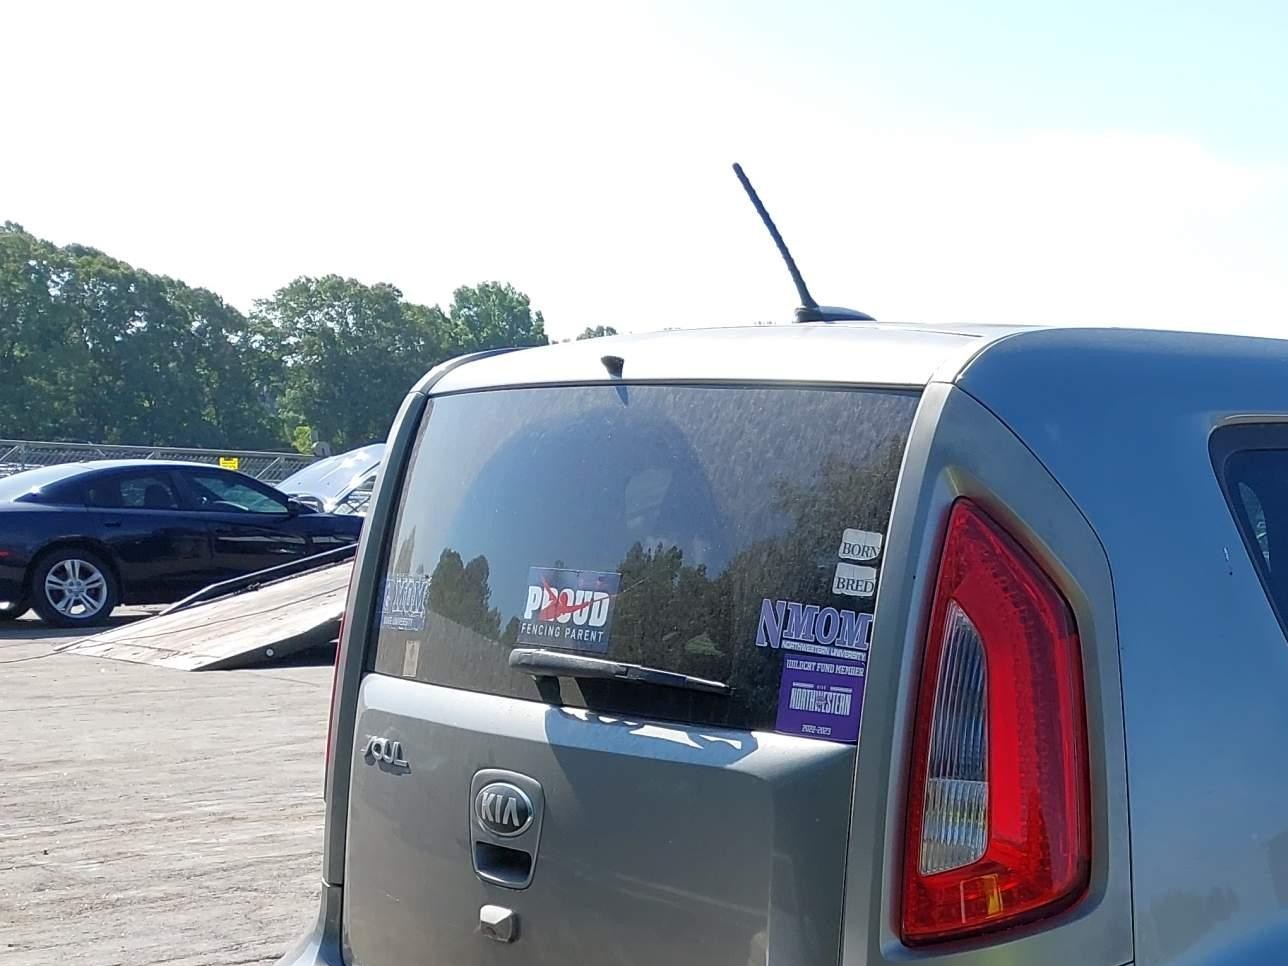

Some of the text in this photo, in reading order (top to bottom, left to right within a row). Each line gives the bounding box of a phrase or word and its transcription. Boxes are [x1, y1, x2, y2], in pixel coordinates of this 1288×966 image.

[841, 542, 881, 558] BORN
[836, 577, 875, 593] BRED
[520, 622, 604, 642] FENCING PARENT
[781, 639, 867, 662] NORTHWESTERN UNIVERSITY
[816, 662, 835, 673] FUND
[789, 687, 852, 716] NORTHWESTERN
[480, 791, 520, 827] KIA
